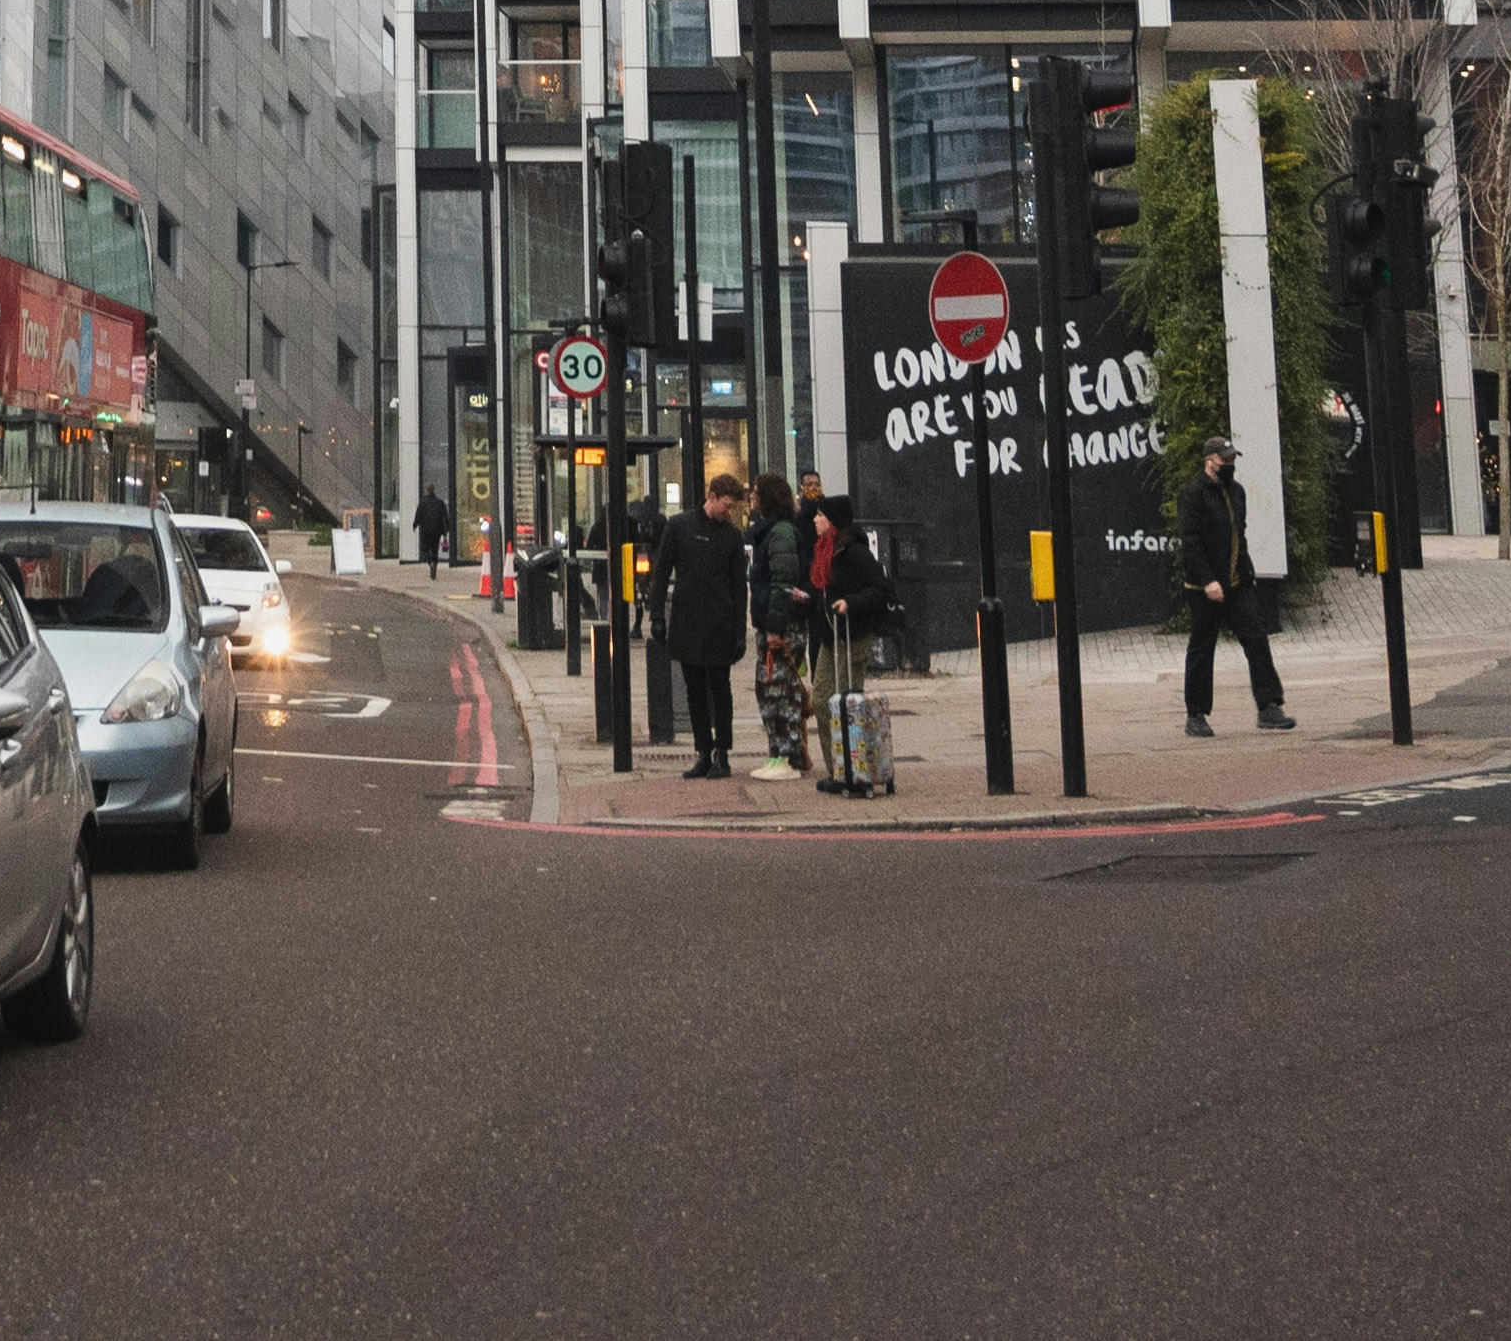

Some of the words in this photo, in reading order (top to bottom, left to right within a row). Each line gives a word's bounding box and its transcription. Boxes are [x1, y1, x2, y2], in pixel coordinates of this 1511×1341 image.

[563, 354, 603, 379] 30
[885, 393, 959, 452] ARE
[1039, 350, 1161, 417] EAD
[466, 437, 490, 501] atis
[1043, 419, 1167, 468] HANGE
